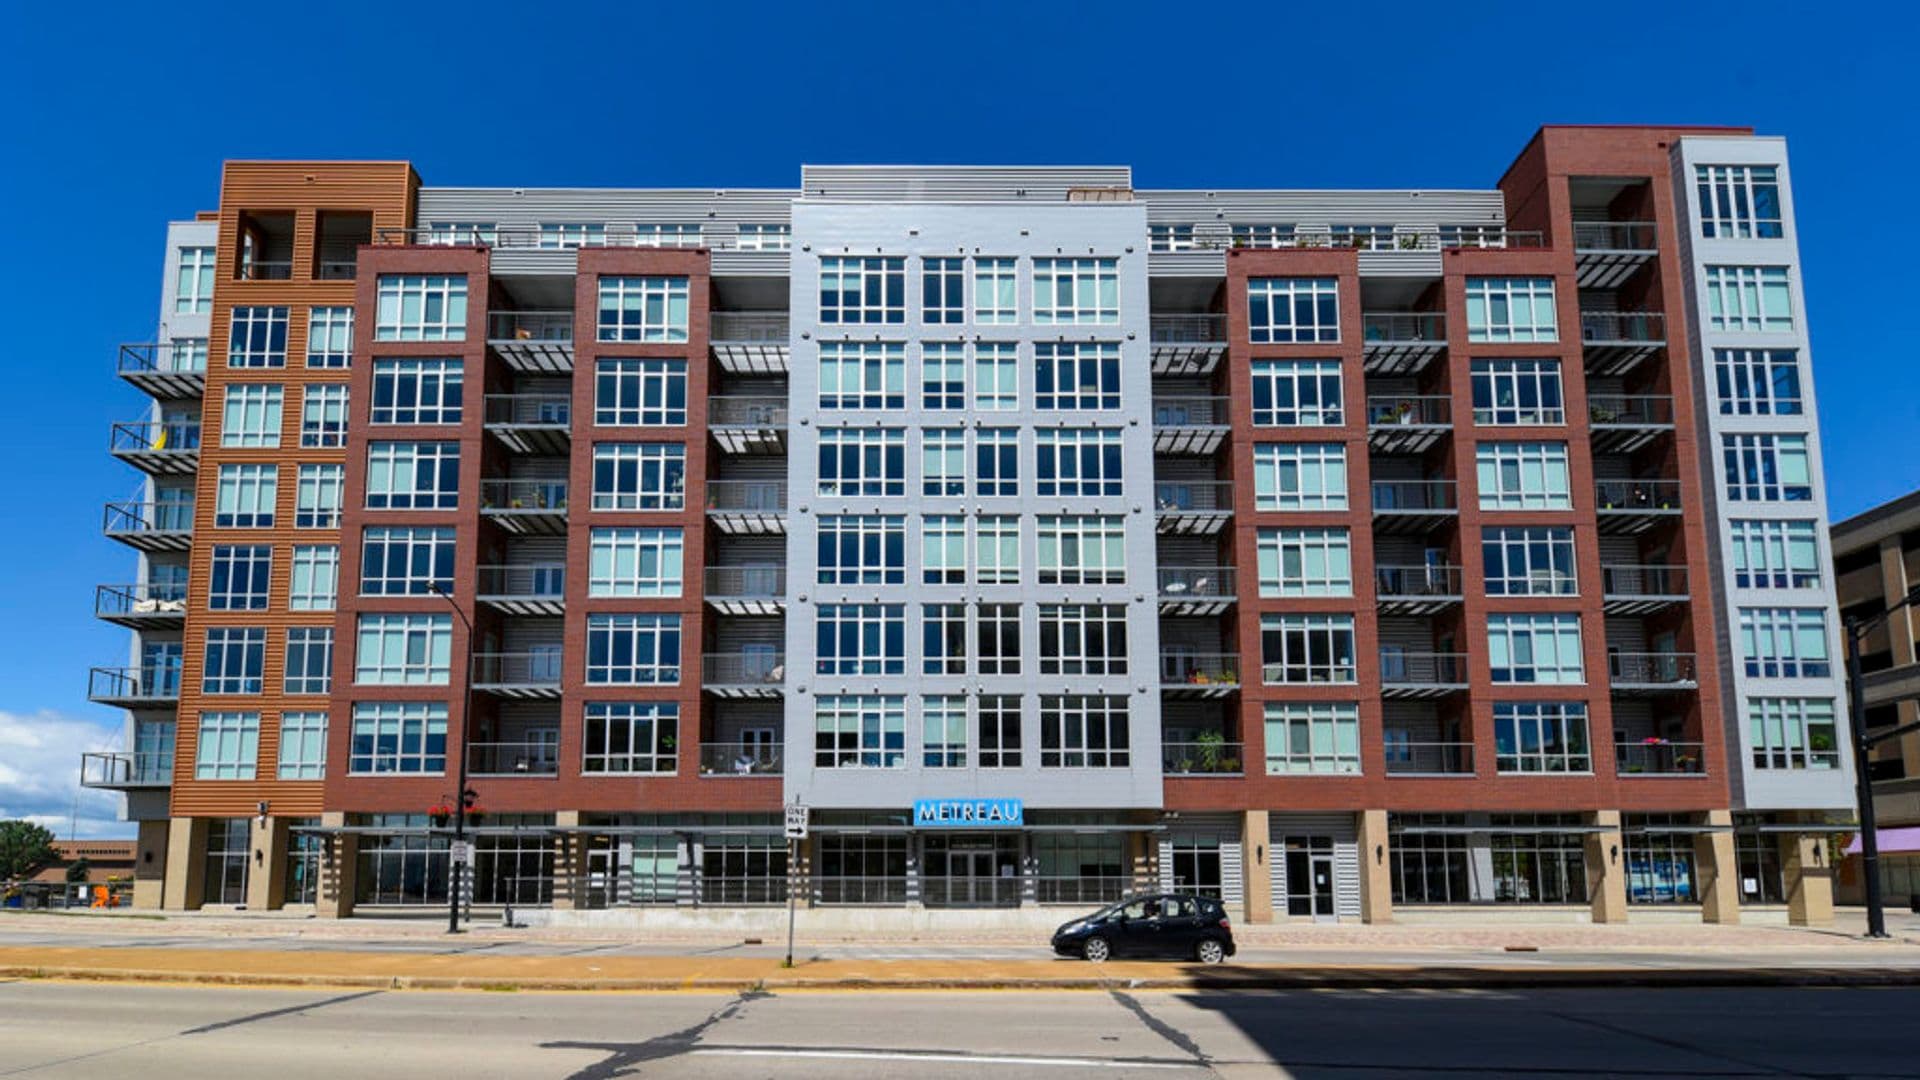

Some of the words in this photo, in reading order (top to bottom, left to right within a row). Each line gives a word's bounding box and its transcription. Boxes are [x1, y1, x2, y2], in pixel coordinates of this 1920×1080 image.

[787, 807, 806, 816] ONE
[919, 802, 1019, 821] METREAU
[787, 817, 806, 825] WAY
